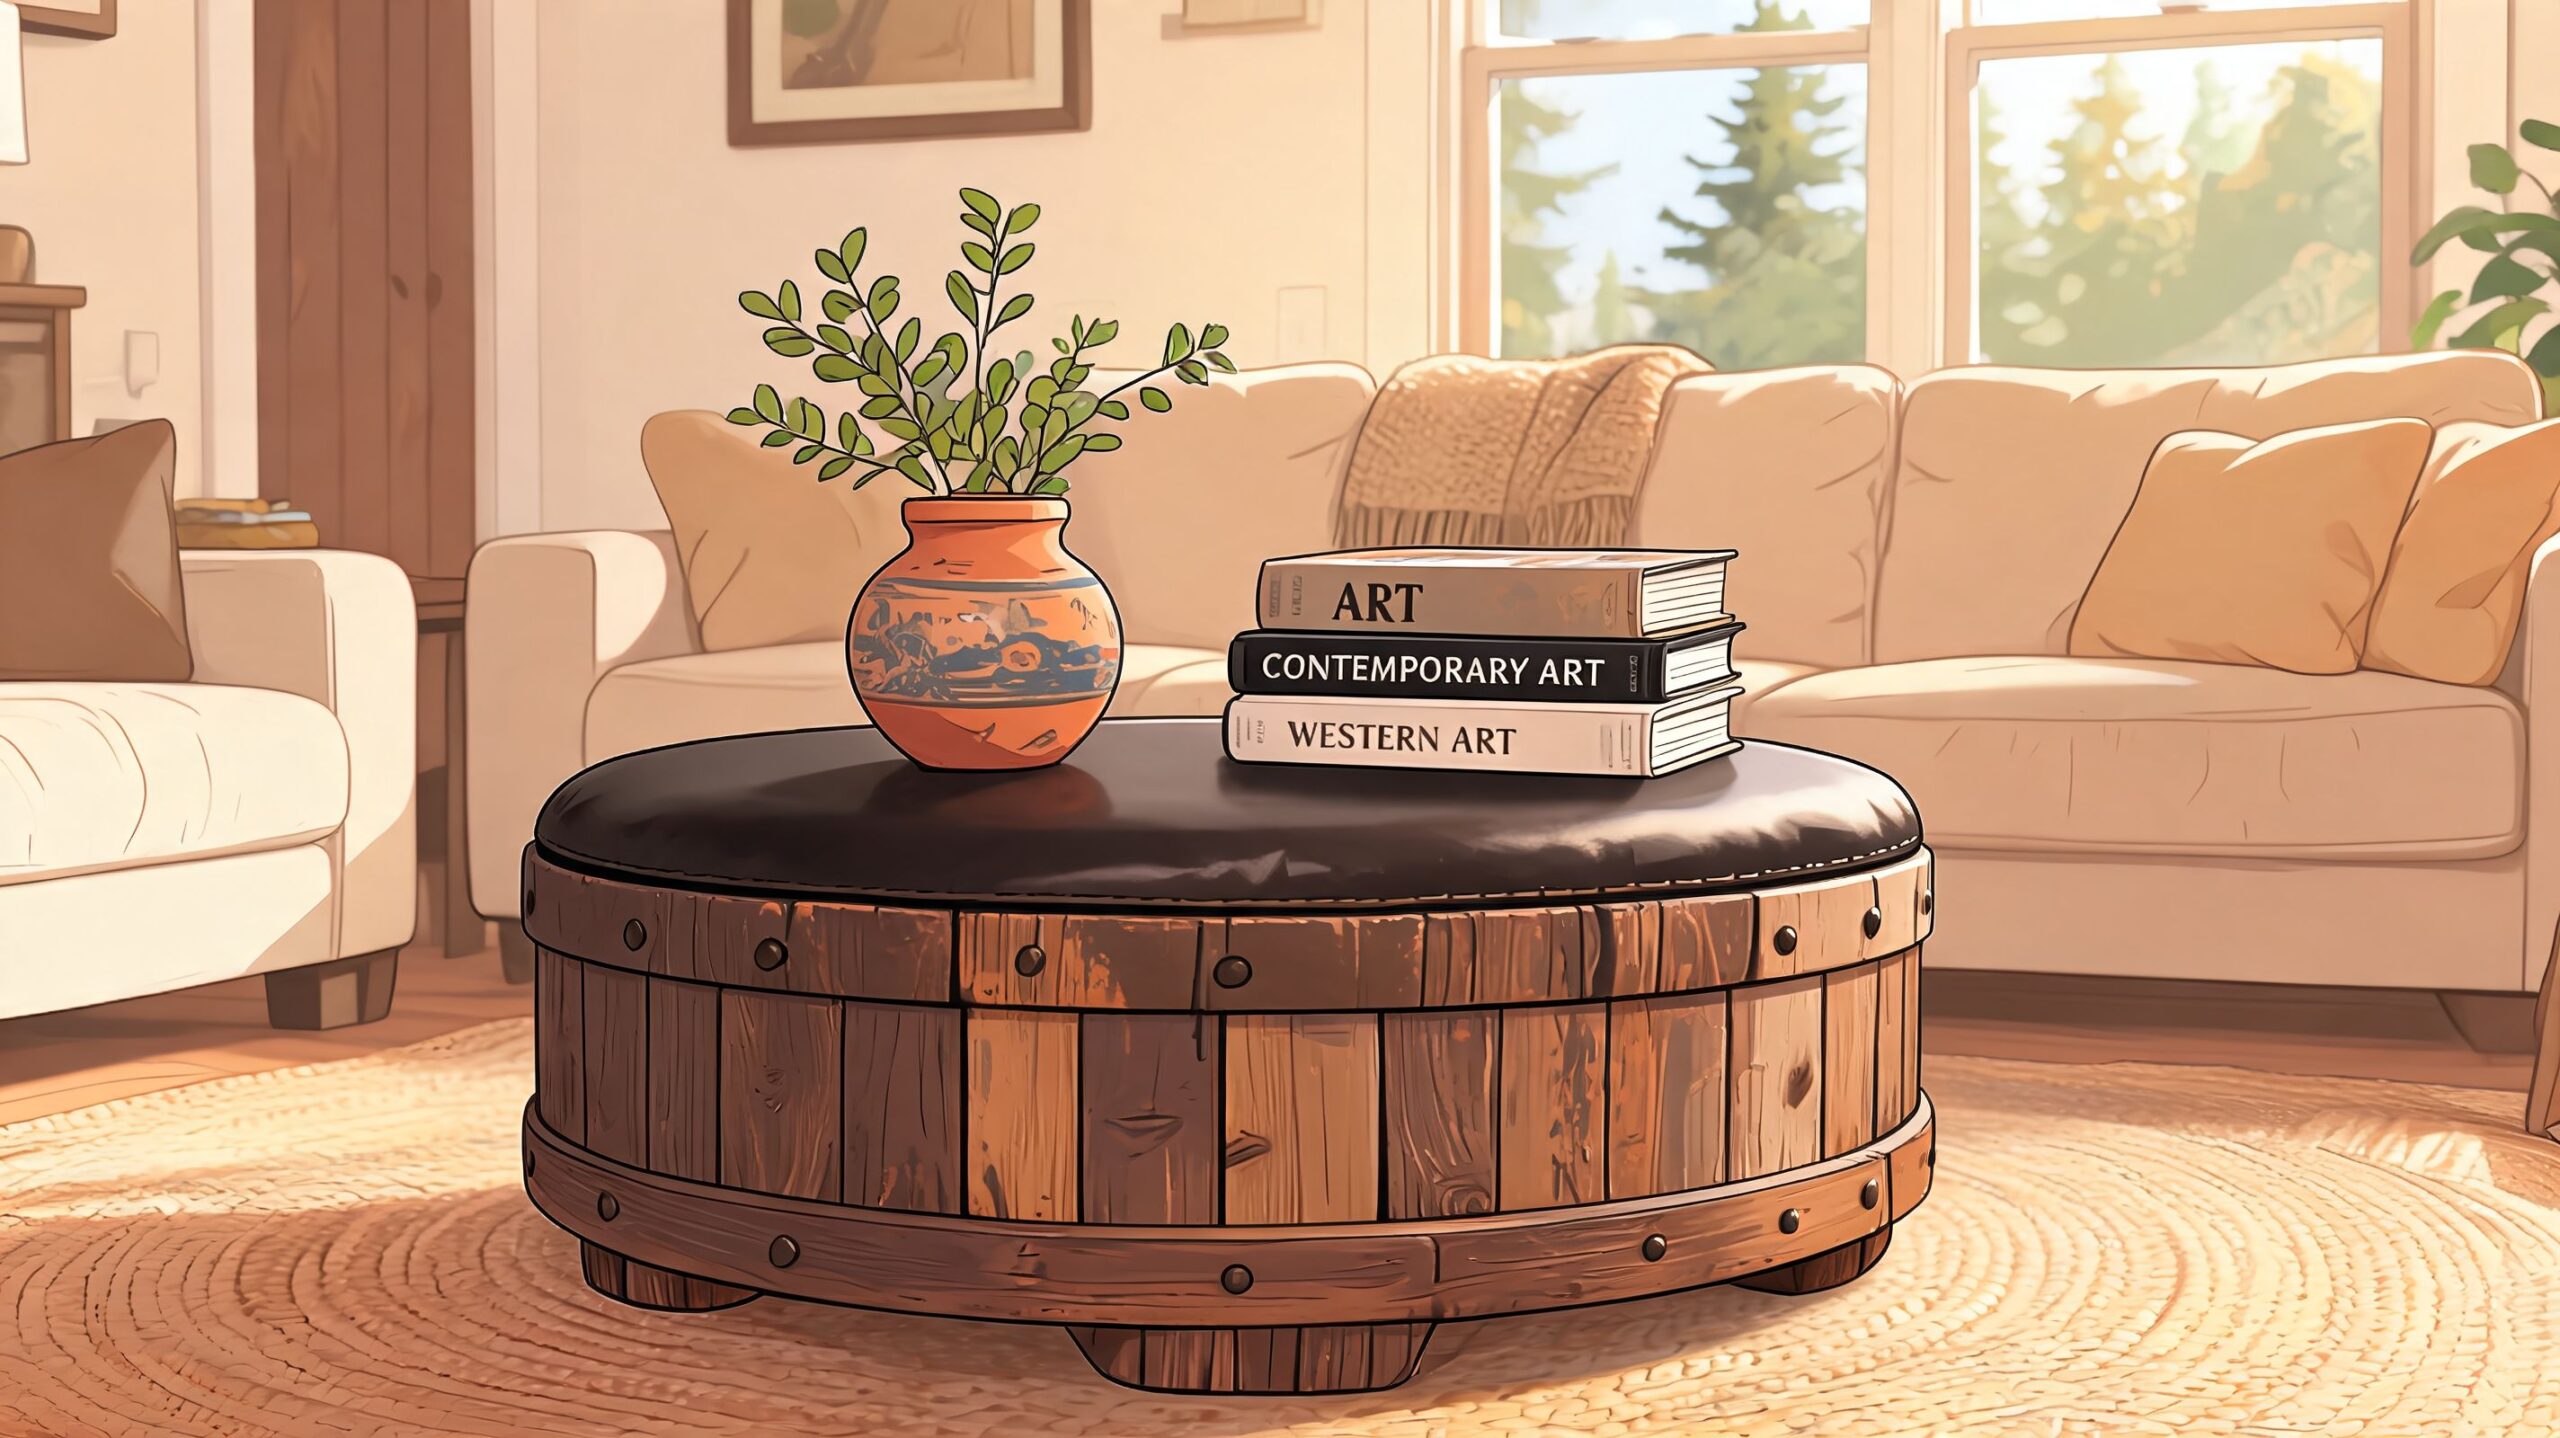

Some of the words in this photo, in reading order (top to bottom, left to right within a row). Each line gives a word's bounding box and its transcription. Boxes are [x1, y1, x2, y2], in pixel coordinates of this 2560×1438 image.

[1331, 582, 1424, 623] ART
[1262, 652, 1530, 685] CONTEMPORARY
[1537, 658, 1606, 687] ART
[1287, 720, 1439, 752] WESTERN
[1451, 726, 1517, 755] ART
